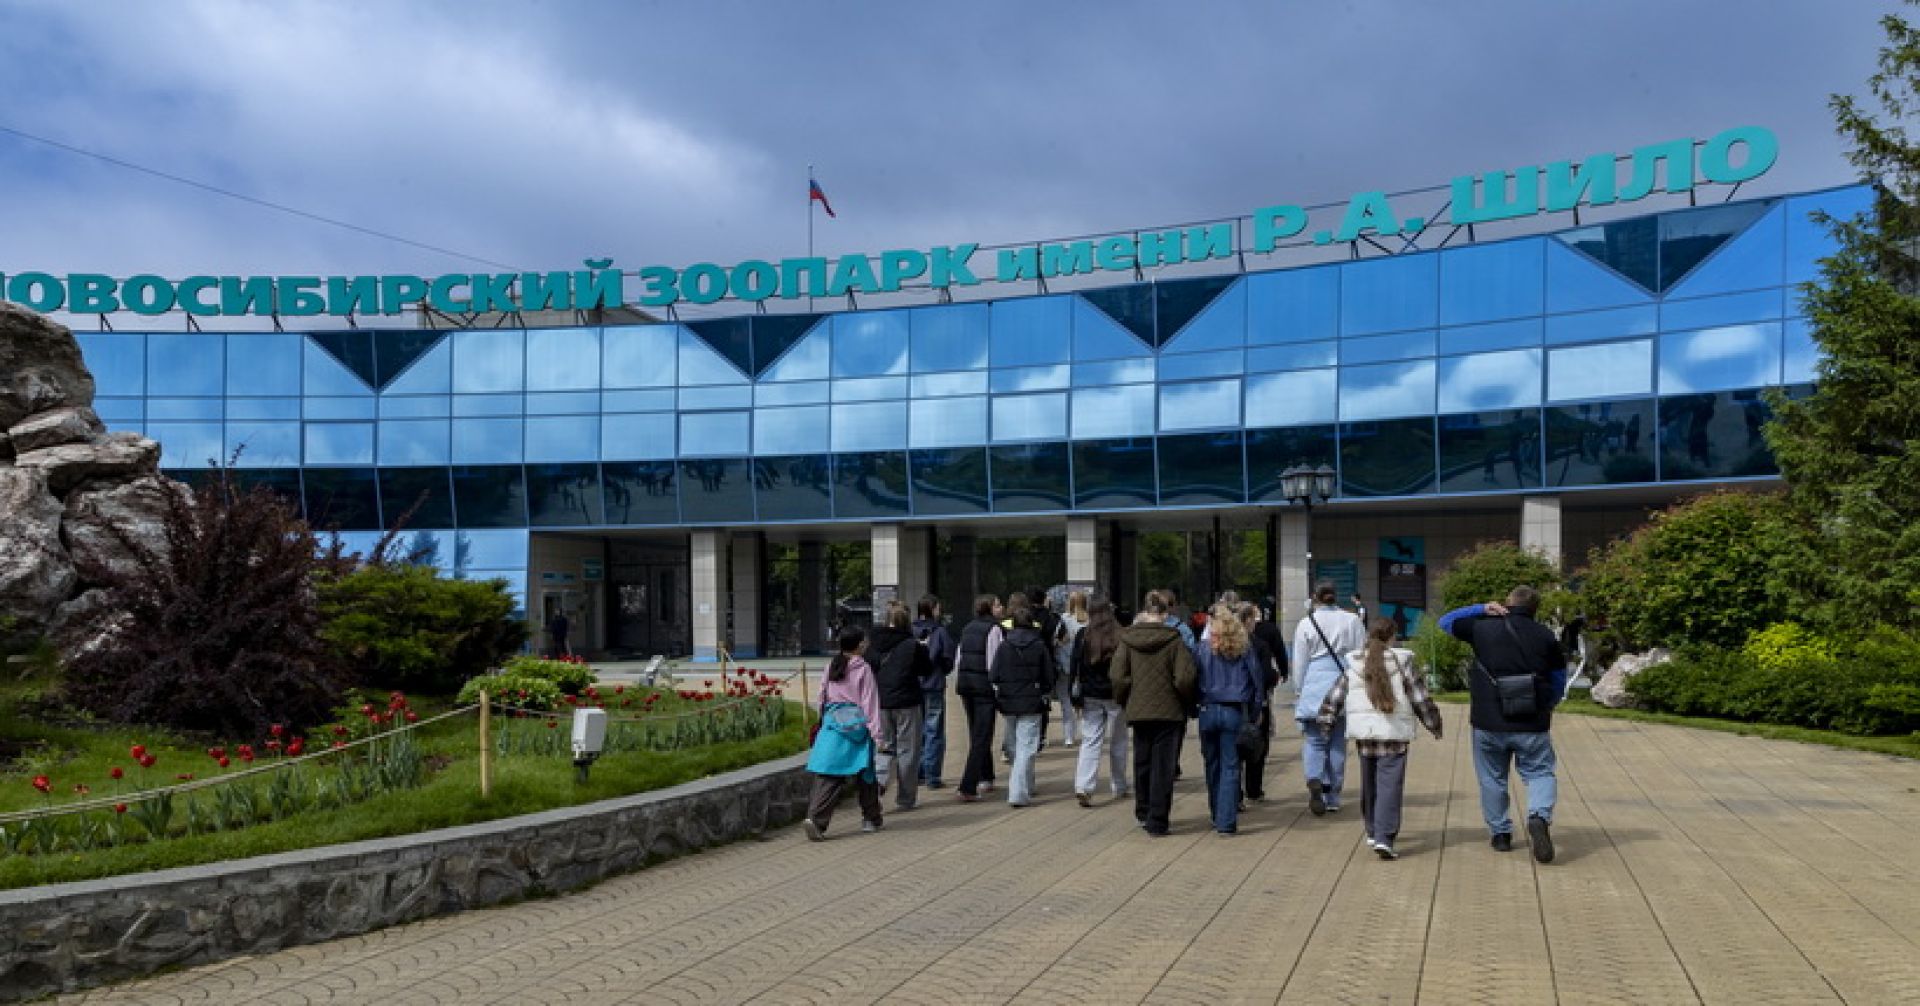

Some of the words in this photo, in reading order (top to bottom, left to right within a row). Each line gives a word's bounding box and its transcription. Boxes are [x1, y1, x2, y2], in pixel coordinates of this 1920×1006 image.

[0, 258, 623, 316] ОВОСИБИРСКИЙ
[640, 244, 979, 306] ЗООПАРК
[996, 224, 1233, 284] имени
[1254, 191, 1426, 255] Р.А.
[1450, 125, 1779, 225] ШИЛО
